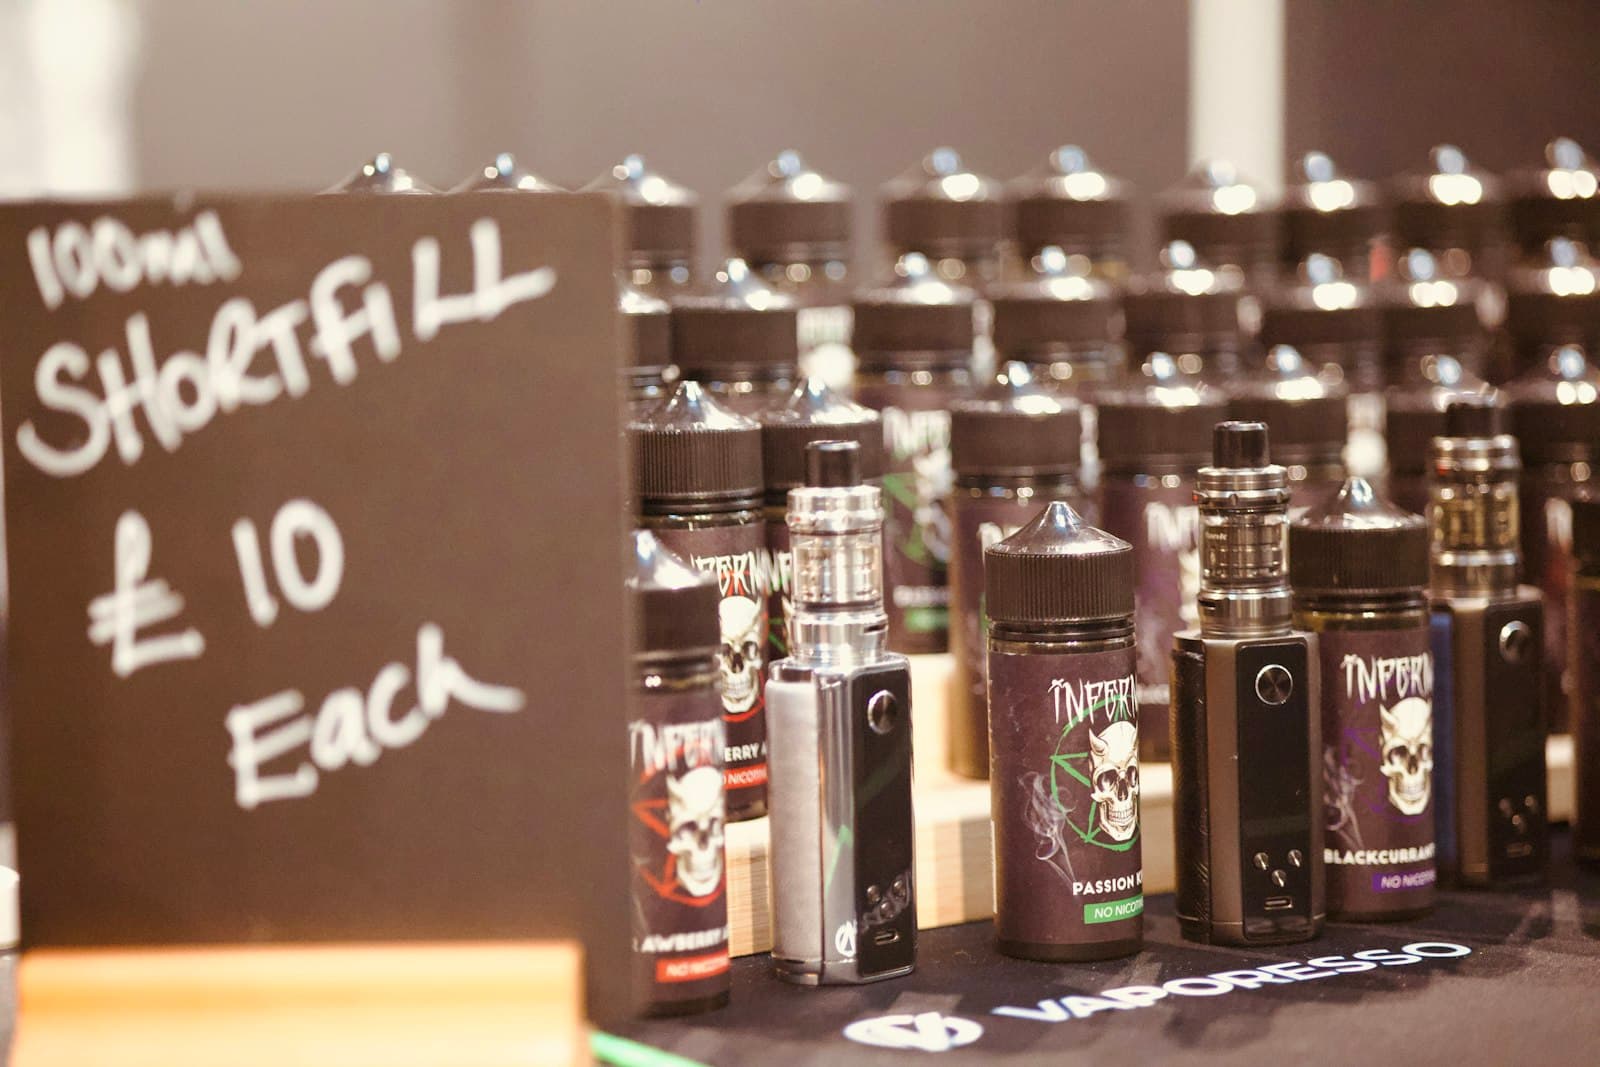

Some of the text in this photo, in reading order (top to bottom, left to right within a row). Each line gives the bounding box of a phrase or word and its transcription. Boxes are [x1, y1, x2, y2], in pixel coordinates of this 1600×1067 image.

[225, 621, 526, 810] Each
[1072, 874, 1135, 896] PASSION
[1094, 906, 1113, 919] NO
[991, 941, 1472, 1023] VAPORESSO
